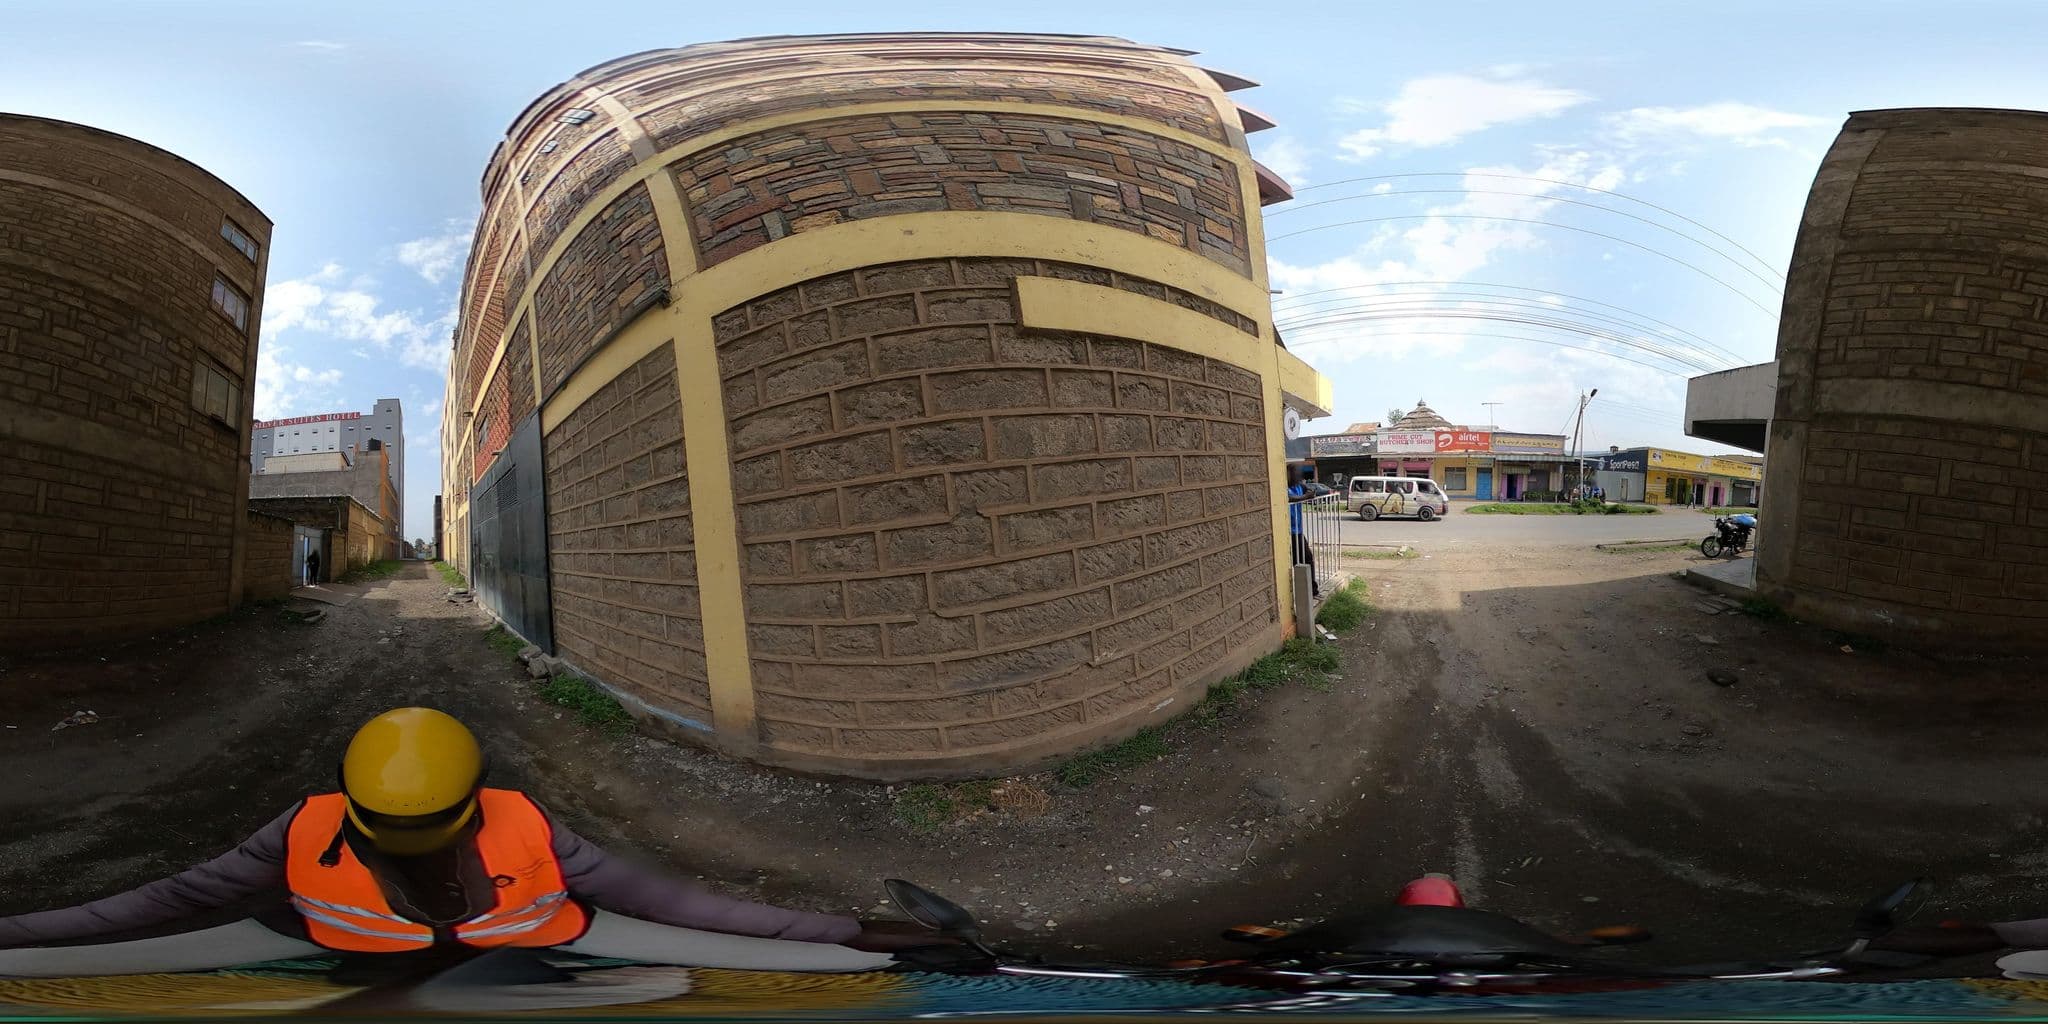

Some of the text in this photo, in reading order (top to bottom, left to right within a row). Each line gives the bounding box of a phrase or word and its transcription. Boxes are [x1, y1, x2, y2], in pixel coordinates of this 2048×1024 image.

[254, 411, 360, 429] SILVER SUITES HOTEL
[1458, 432, 1480, 441] airtel
[1609, 459, 1640, 472] SportPesa
